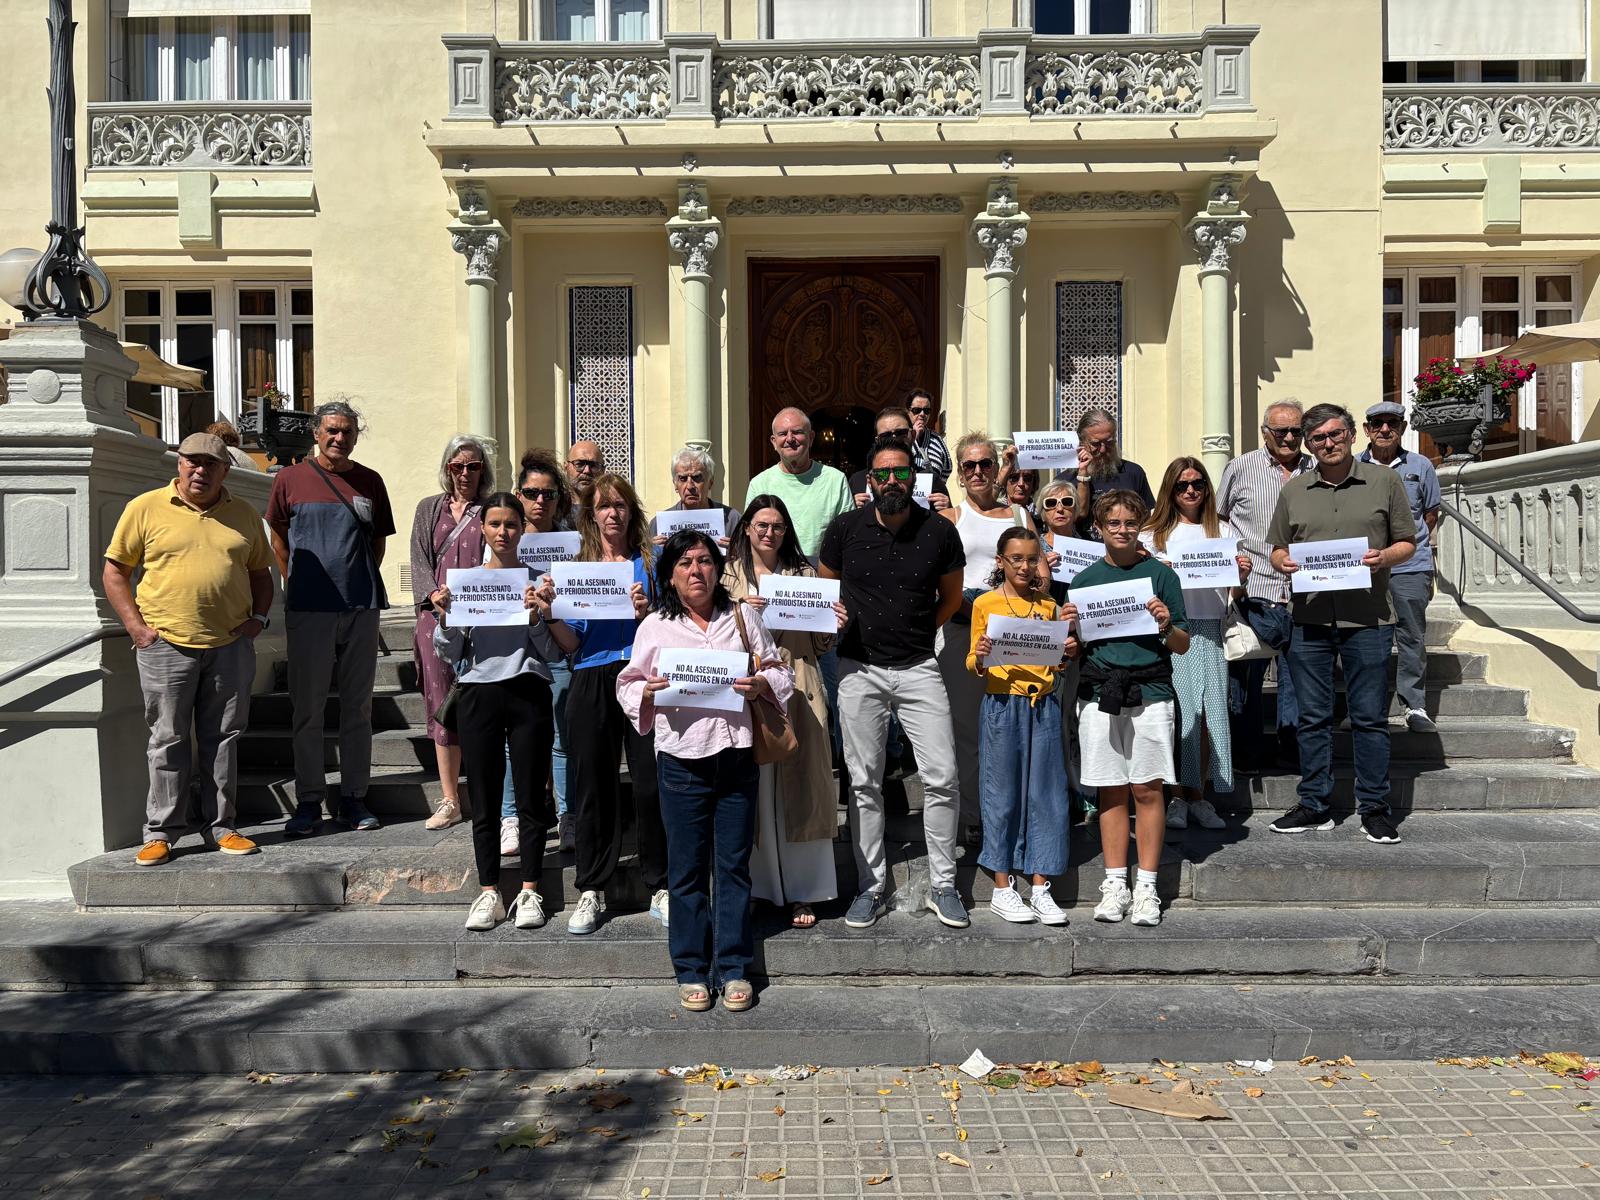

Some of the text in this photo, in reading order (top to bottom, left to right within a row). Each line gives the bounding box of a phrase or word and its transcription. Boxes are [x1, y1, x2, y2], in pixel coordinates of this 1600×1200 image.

[1080, 552, 1099, 560] ASESINAT
[1322, 553, 1351, 561] ASESINATO
[1304, 562, 1337, 571] PERIODISTAS
[772, 598, 806, 607] PERIODISTAS
[1105, 596, 1136, 607] ASESINATO
[1086, 608, 1122, 619] PERIODISTAS
[1020, 634, 1050, 642] ASESINATO
[695, 666, 728, 675] ASESINATO
[672, 673, 710, 683] PERIODISTAS
